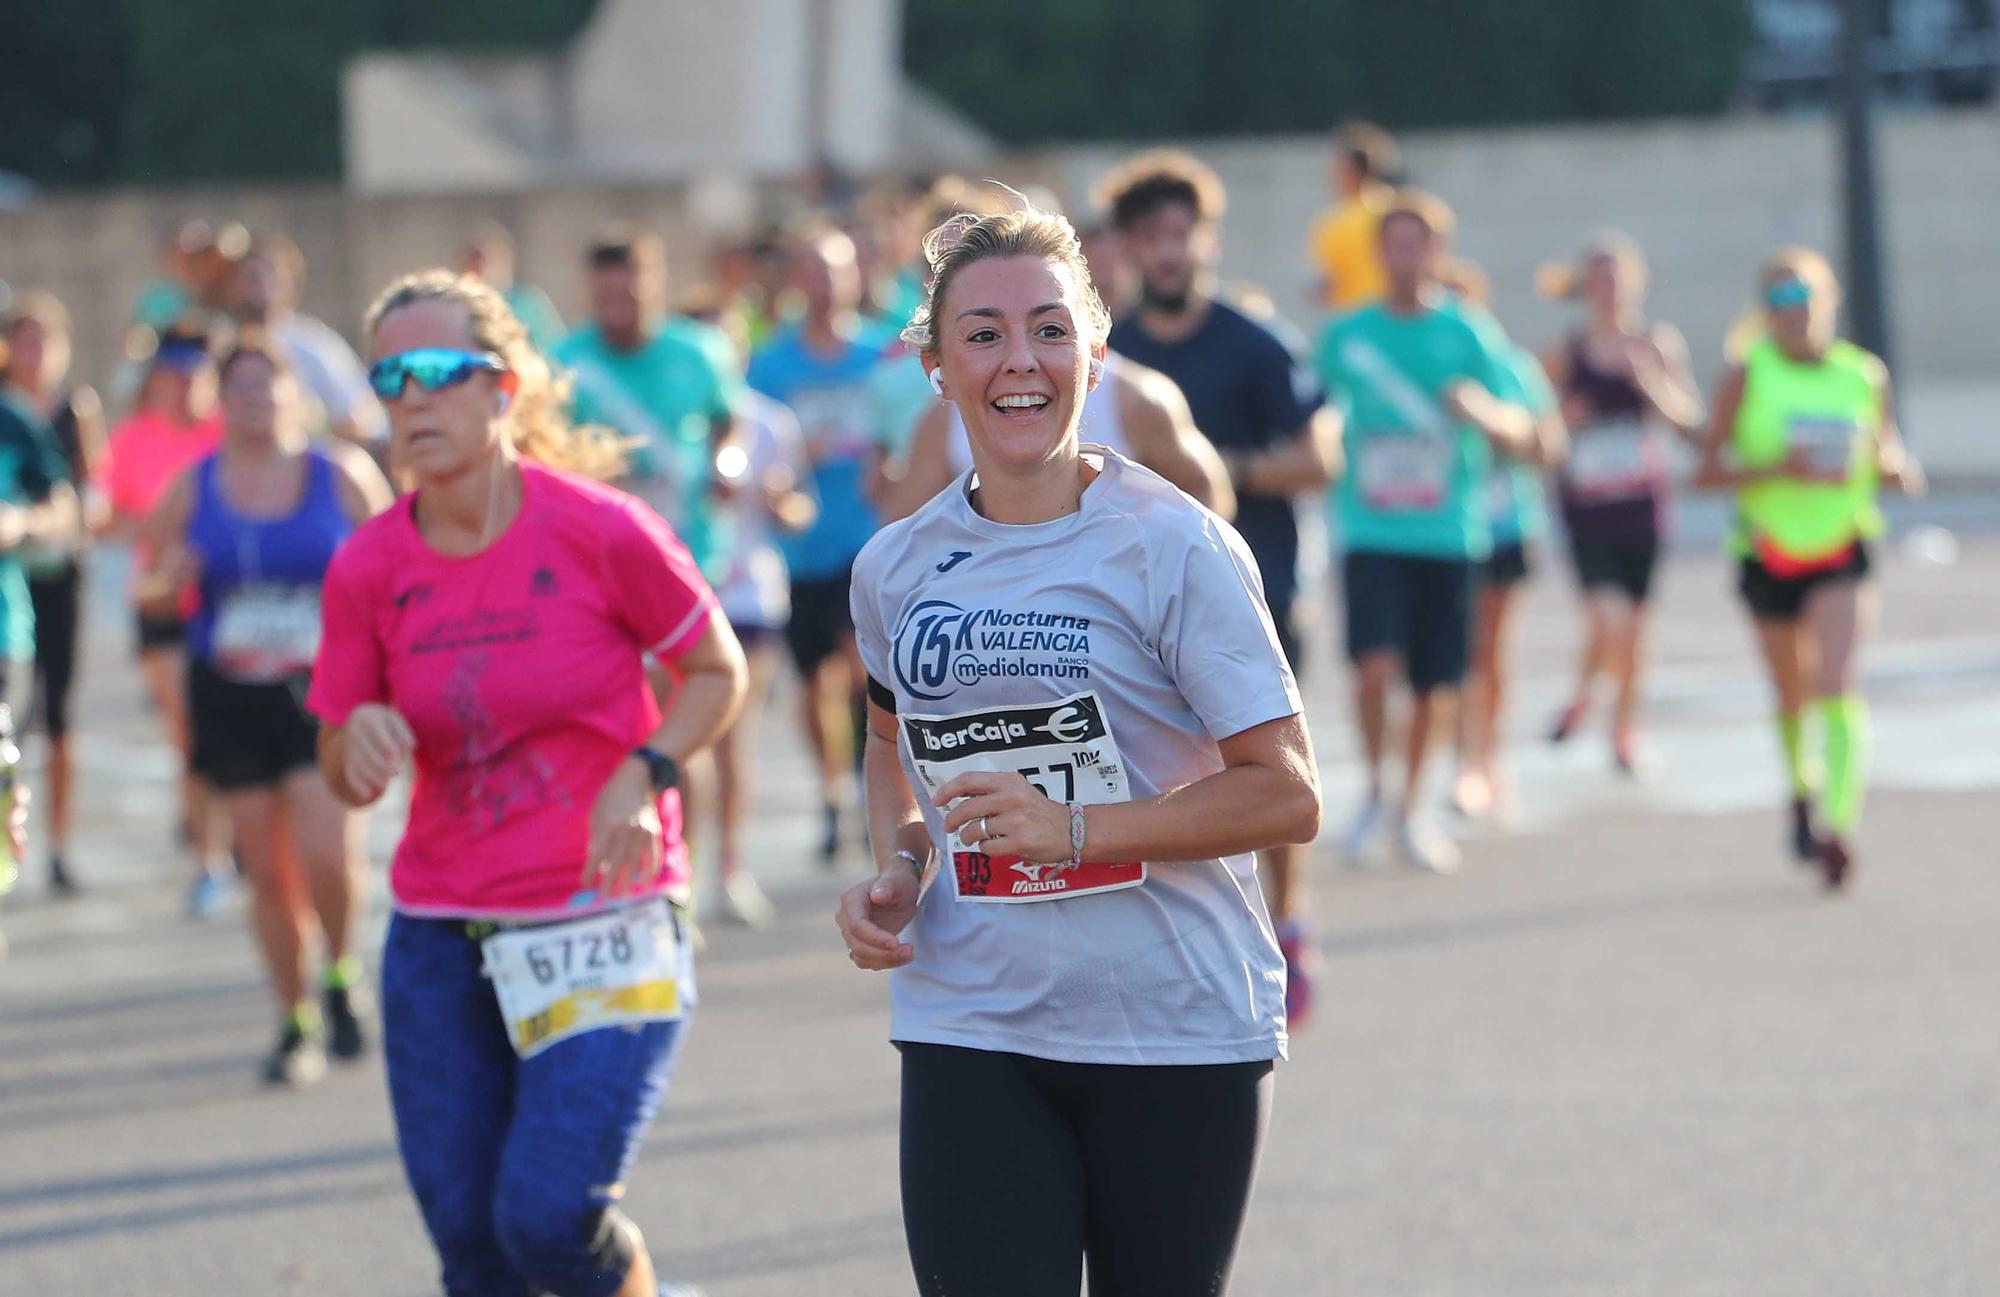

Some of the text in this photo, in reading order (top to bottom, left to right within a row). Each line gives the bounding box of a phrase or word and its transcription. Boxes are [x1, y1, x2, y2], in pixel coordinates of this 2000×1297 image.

[982, 609, 1090, 631] Nocturna
[980, 631, 1090, 653] VALENCIA
[958, 656, 1089, 680] mediolanum
[1058, 656, 1089, 666] BANCO
[1072, 750, 1100, 768] 10K
[1011, 879, 1066, 894] MIZUNO
[526, 925, 633, 986] 6728
